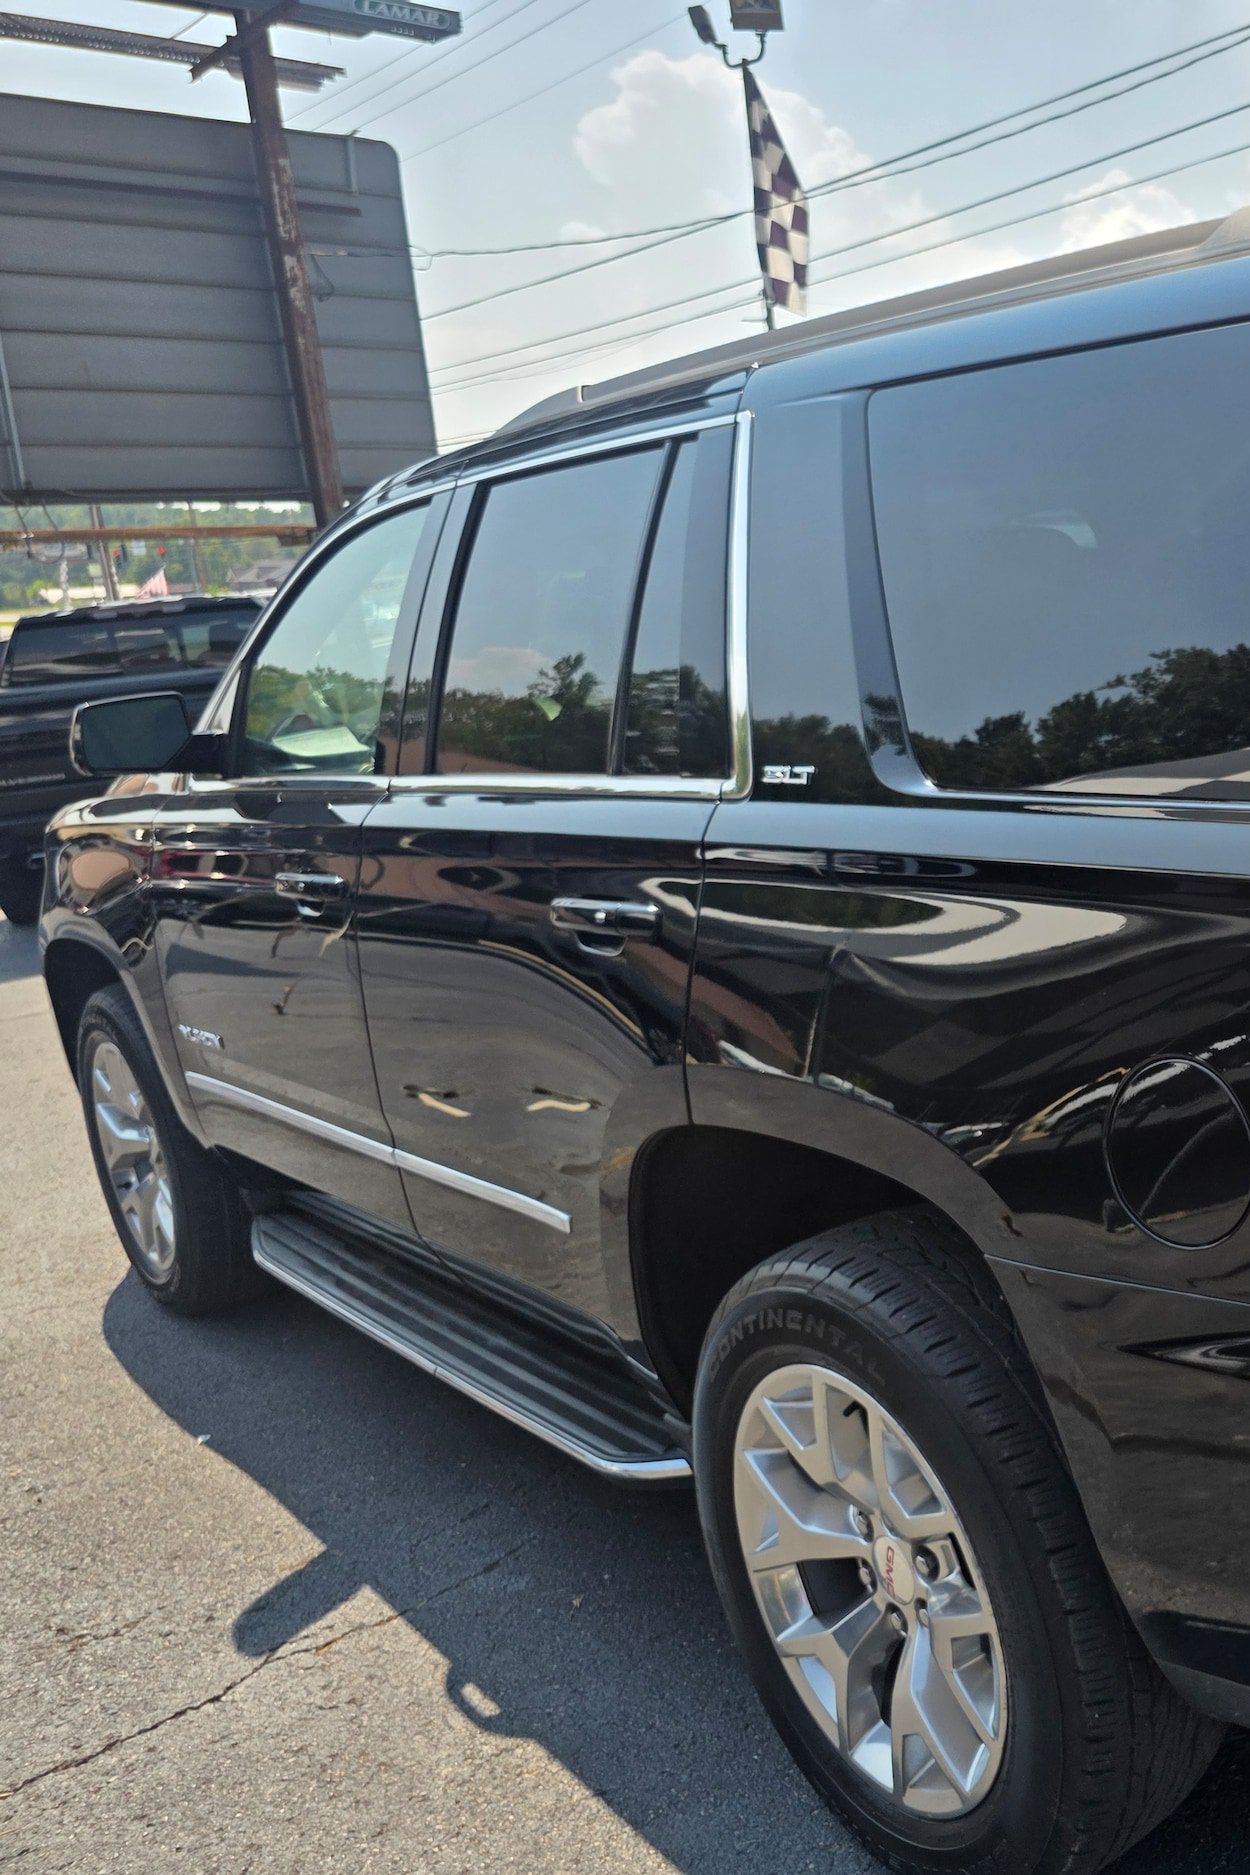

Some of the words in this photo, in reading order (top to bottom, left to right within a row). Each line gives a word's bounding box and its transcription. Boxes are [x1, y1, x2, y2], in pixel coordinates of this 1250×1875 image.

[363, 0, 440, 26] LAMAR
[762, 765, 815, 784] SLT
[710, 1308, 886, 1386] CONTINENTAL
[886, 1545, 895, 1599] GMC
